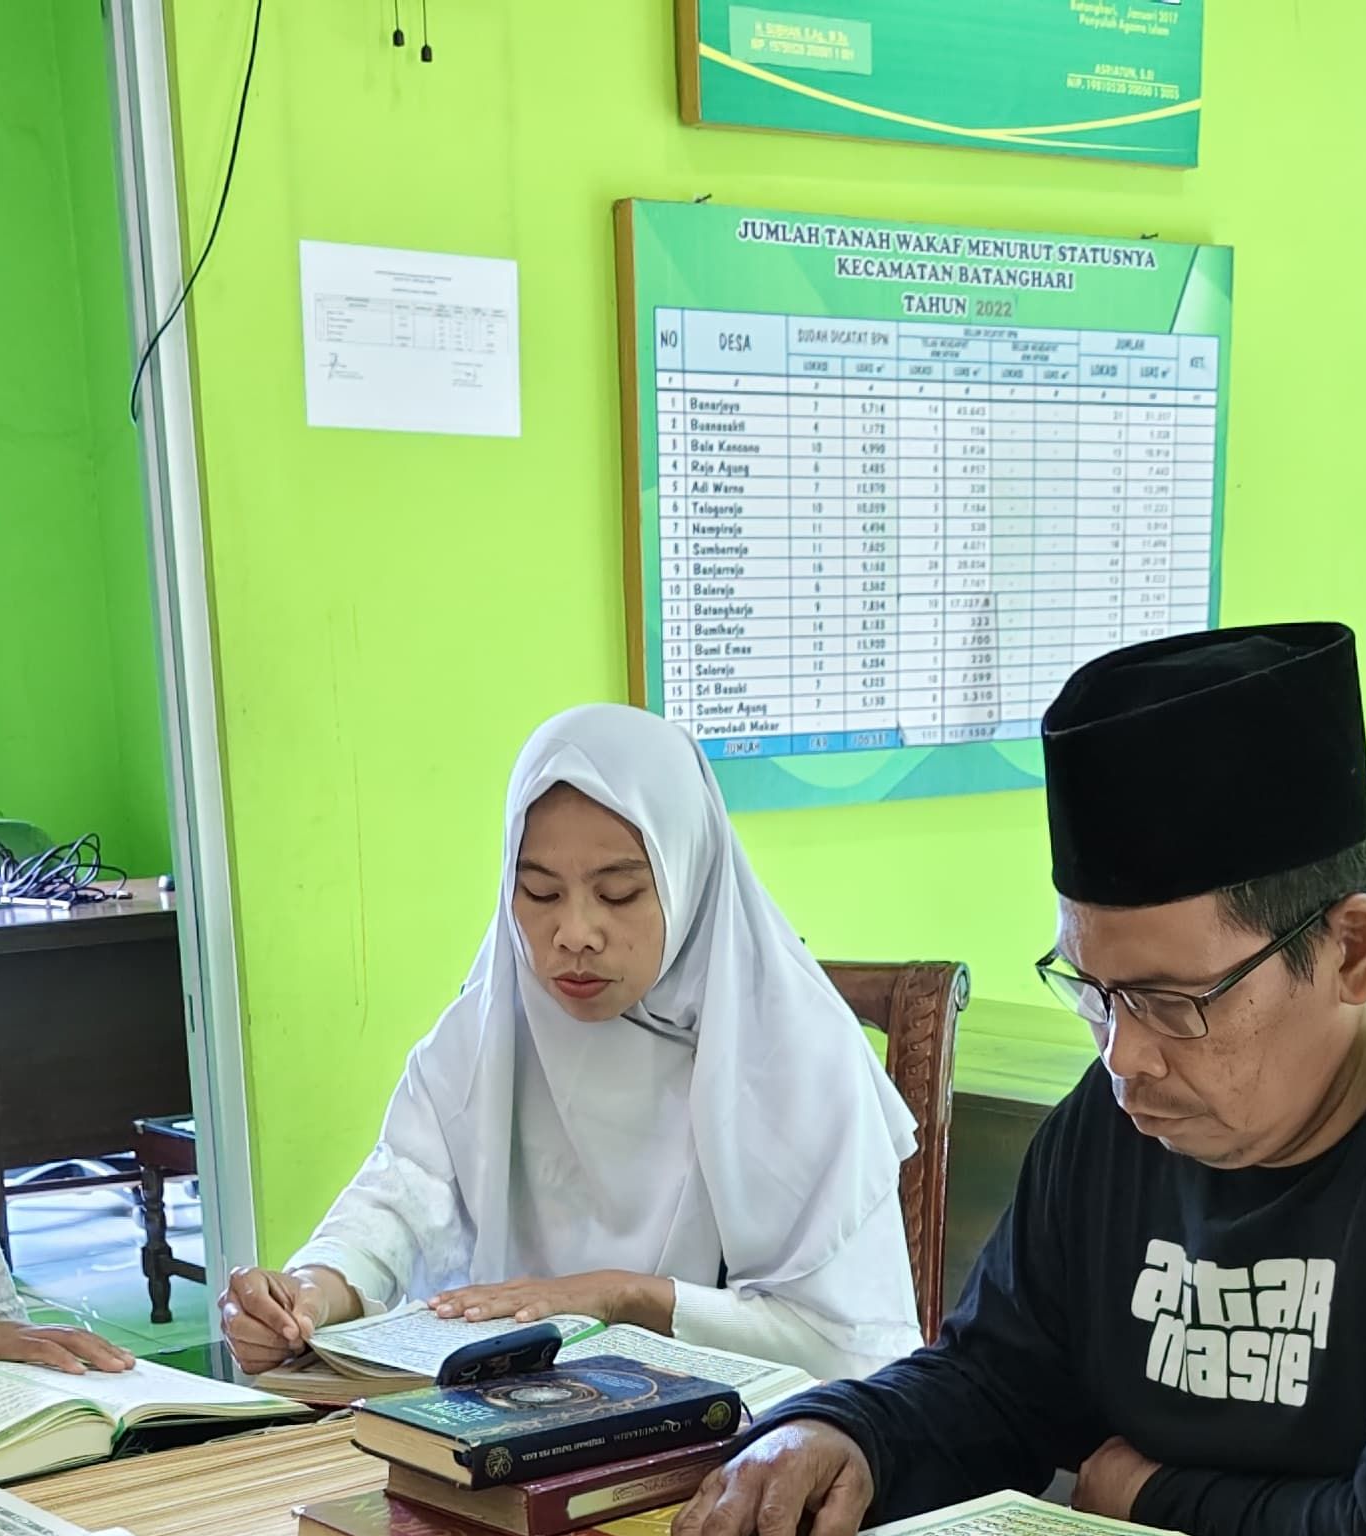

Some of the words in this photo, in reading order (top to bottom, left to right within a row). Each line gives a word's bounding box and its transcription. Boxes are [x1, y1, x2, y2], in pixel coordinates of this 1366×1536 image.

[738, 220, 820, 245] JUMLAH
[825, 227, 891, 250] TANAH
[896, 233, 963, 255] WAKAF
[967, 239, 1056, 261] MENURUT
[1058, 246, 1156, 269] STATUSNYA
[837, 257, 953, 282] KECAMATAN
[959, 267, 1075, 290] BATANGHARI
[904, 295, 967, 315] TAHUN
[976, 300, 1012, 318] 2022
[660, 331, 678, 349] NO
[719, 332, 752, 352] DESA
